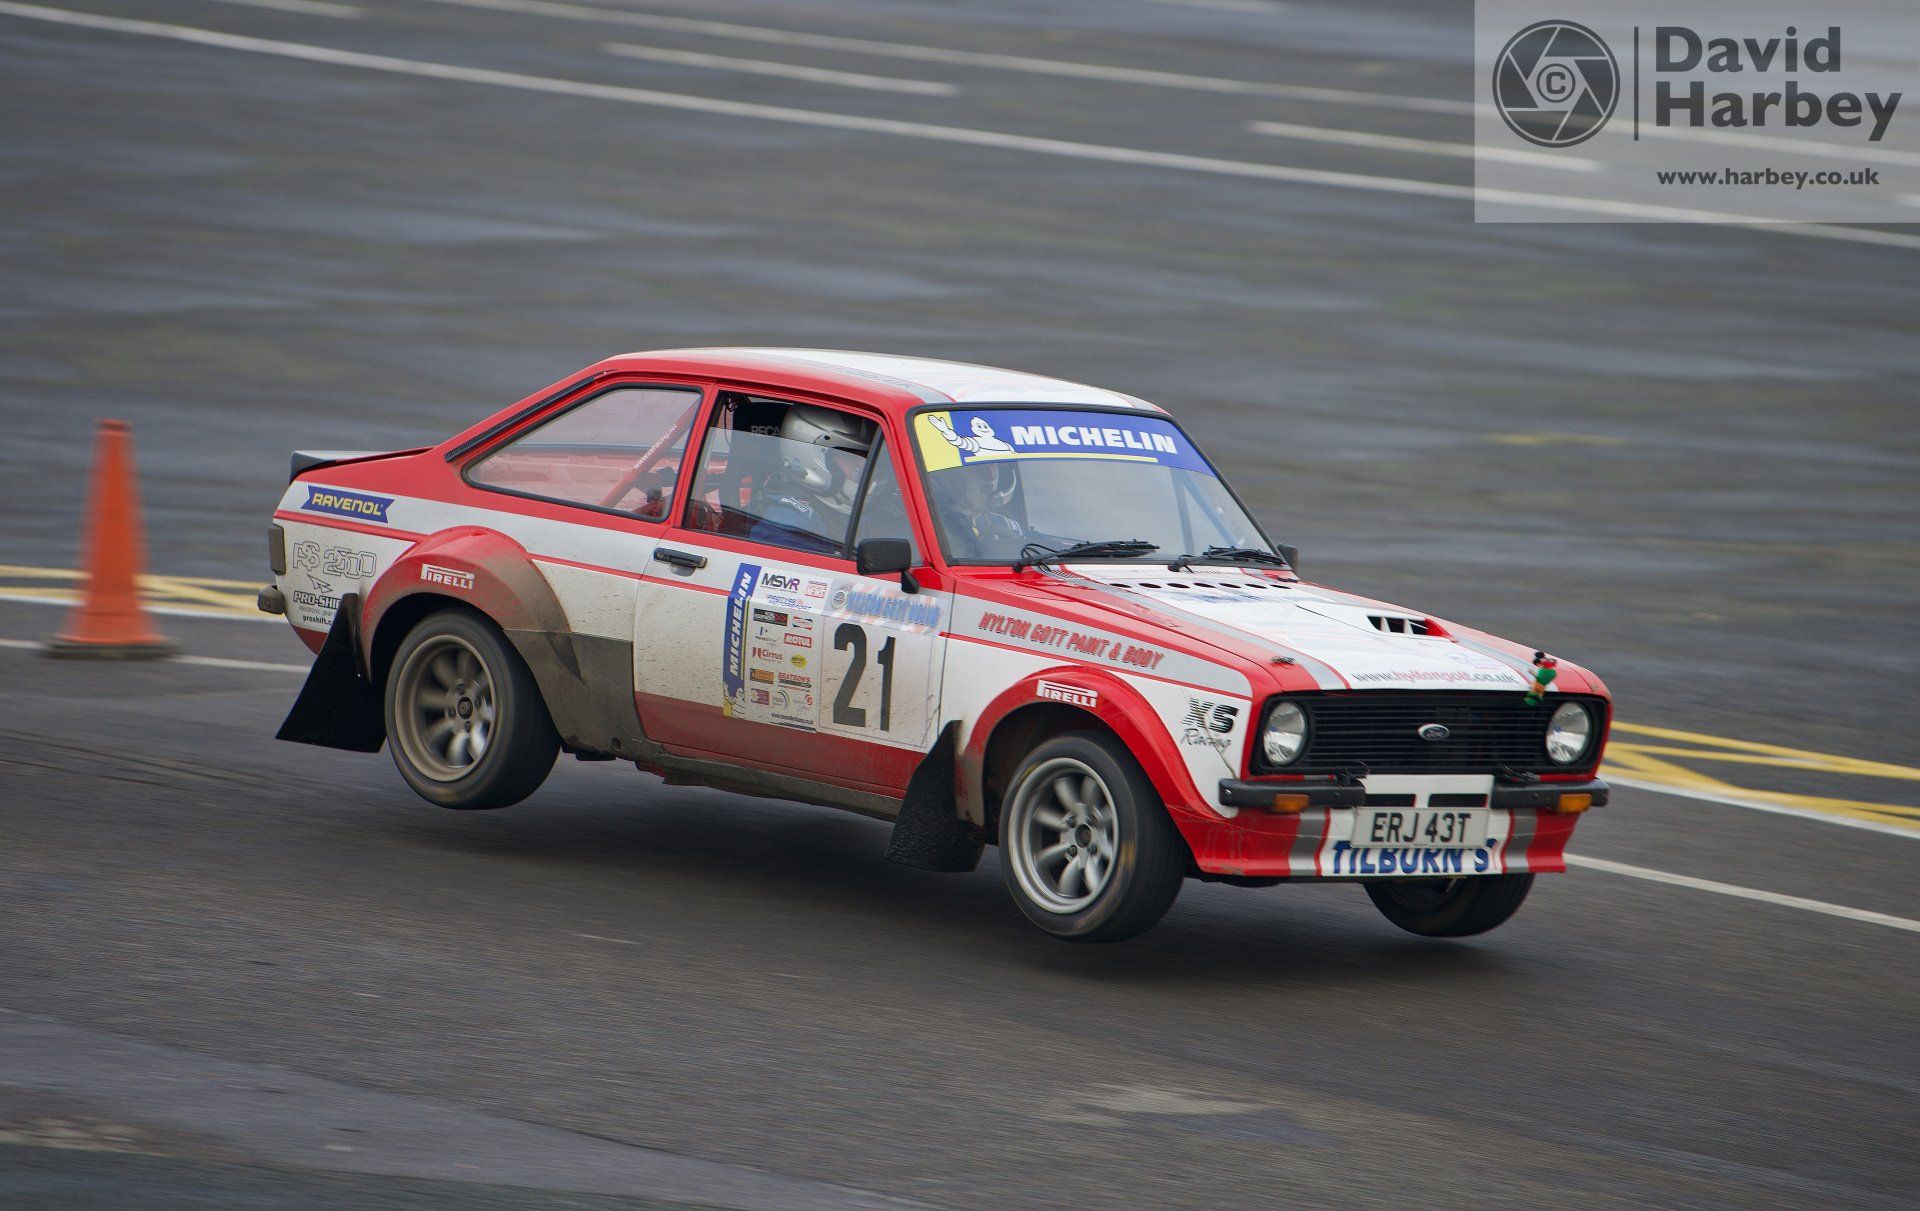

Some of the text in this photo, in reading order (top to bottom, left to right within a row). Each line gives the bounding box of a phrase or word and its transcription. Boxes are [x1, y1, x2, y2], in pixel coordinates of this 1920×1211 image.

[1010, 425, 1178, 454] MICHELIN
[311, 492, 382, 516] RAVENOL
[293, 540, 321, 571] RS
[421, 563, 475, 590] PIRELLI
[761, 573, 800, 591] MSVR
[303, 615, 332, 626] proshift.c
[730, 572, 752, 677] MICHELIN
[978, 611, 1165, 670] HYLTON GOTT PAINT & BODY
[832, 622, 896, 732] 21
[1036, 680, 1099, 708] PIRELLI
[1371, 812, 1472, 843] ERJ 43T
